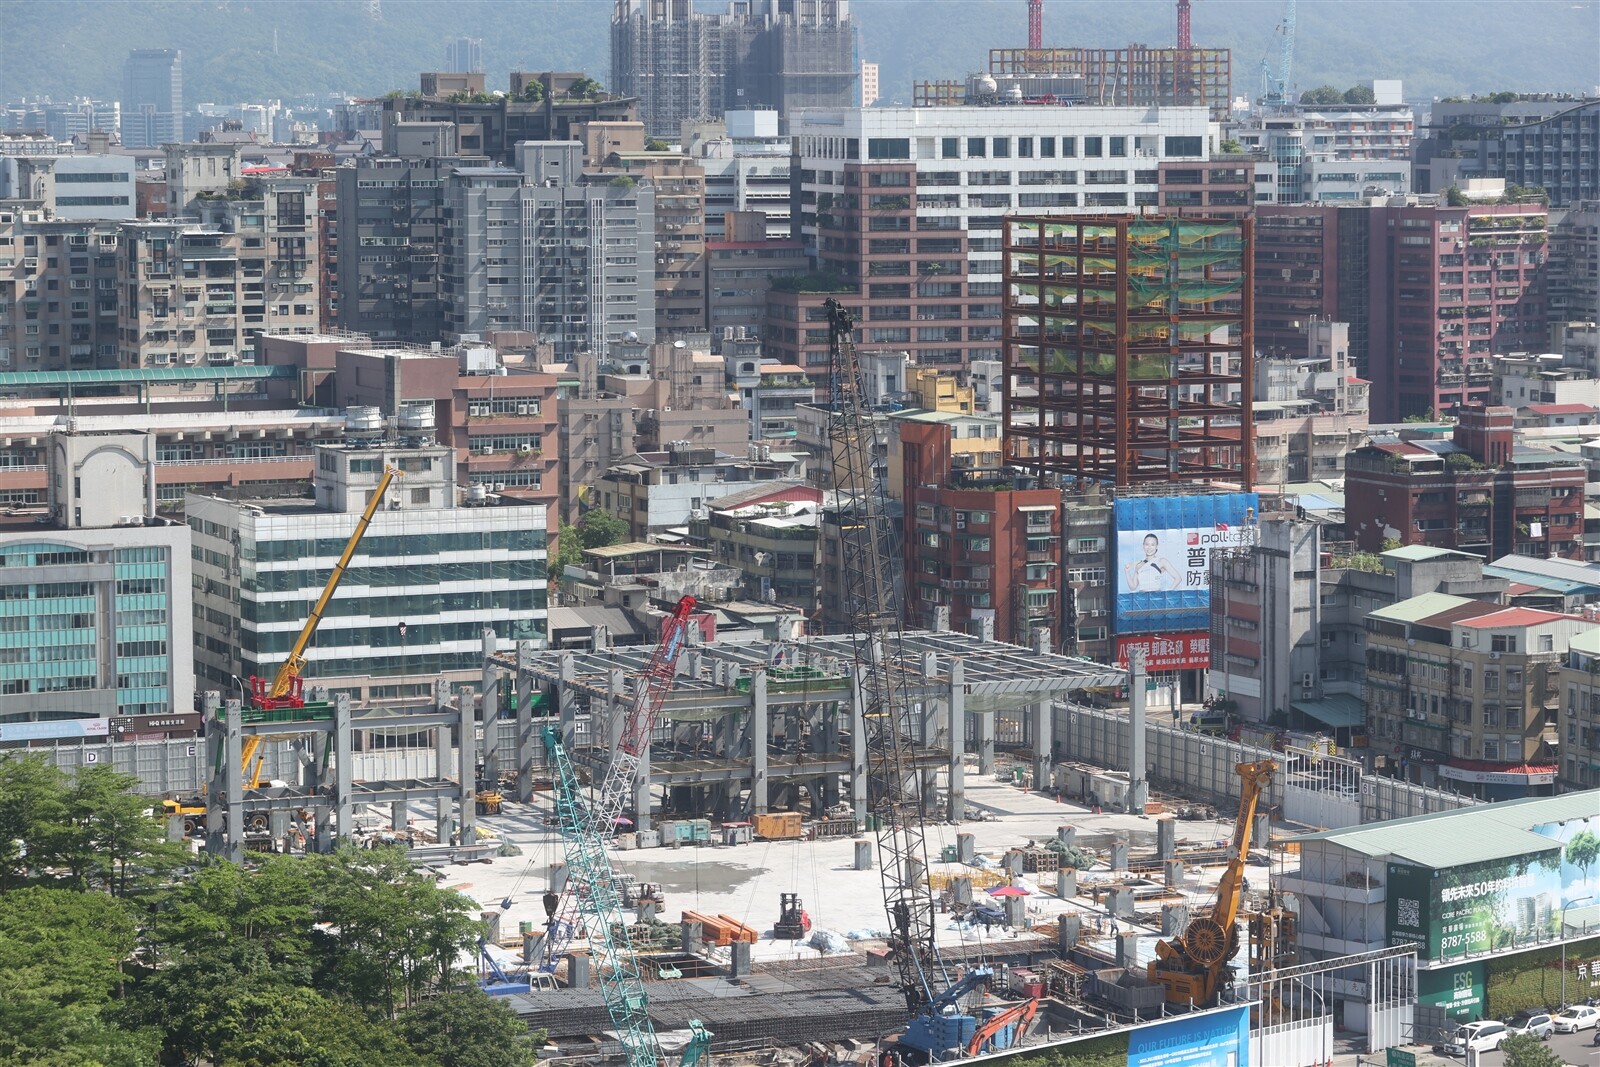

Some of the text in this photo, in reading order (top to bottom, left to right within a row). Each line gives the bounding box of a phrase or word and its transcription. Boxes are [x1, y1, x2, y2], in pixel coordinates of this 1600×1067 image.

[1187, 548, 1206, 567] 普
[1072, 714, 1076, 723] 2
[576, 723, 584, 732] H
[188, 746, 195, 755] E
[1201, 745, 1206, 754] 4
[88, 753, 96, 761] D
[1235, 754, 1240, 763] 5
[1363, 783, 1368, 794] 6
[1391, 937, 1426, 949] 87875588
[1441, 930, 1486, 949] 8787-5588
[1453, 970, 1472, 991] ESG
[1138, 1024, 1237, 1053] OUR FUTURE IS NATURE
